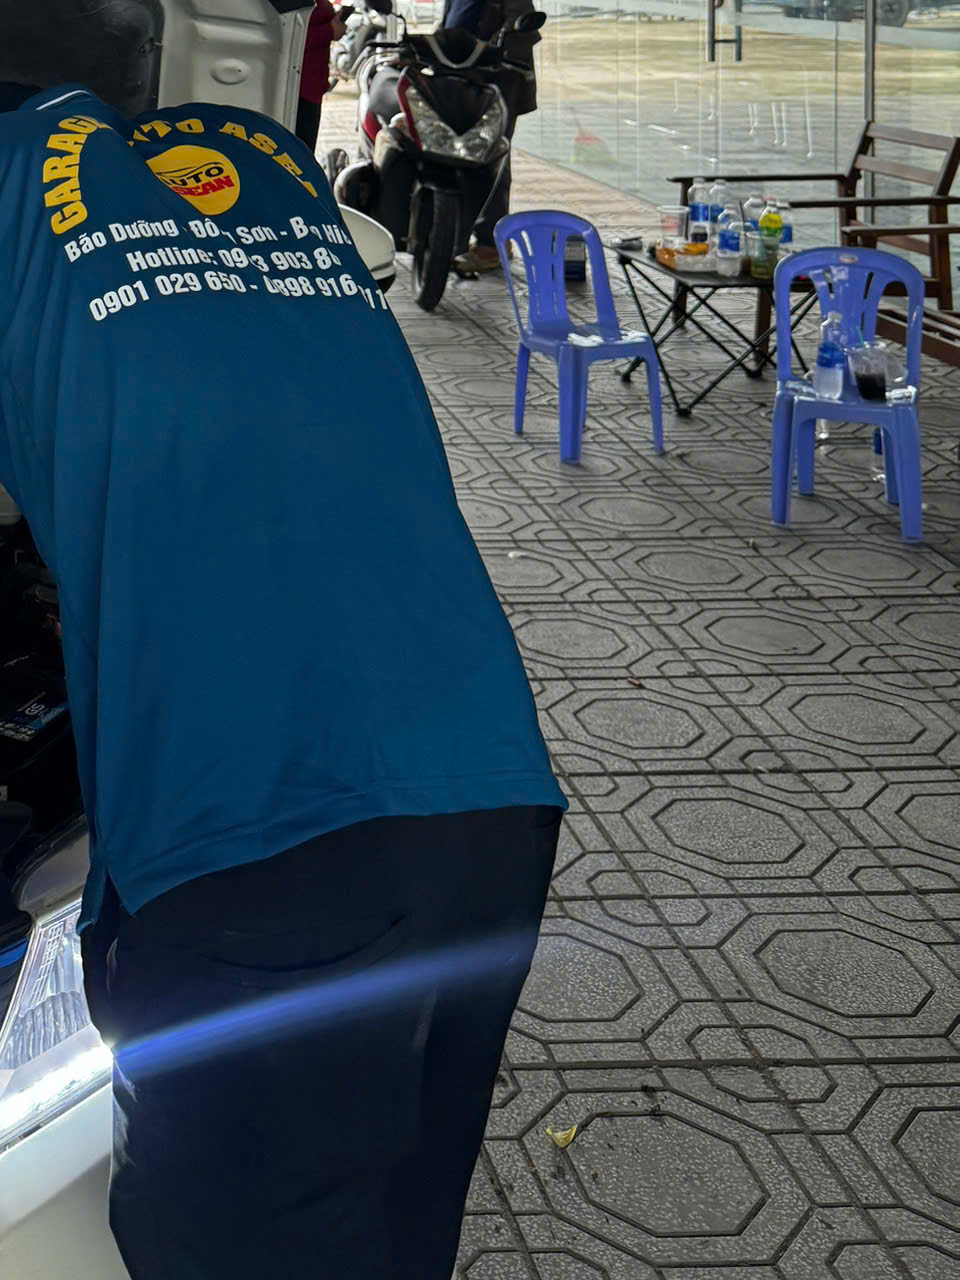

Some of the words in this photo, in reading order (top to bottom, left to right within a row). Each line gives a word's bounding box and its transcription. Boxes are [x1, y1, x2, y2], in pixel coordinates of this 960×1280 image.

[108, 219, 179, 243] Dưỡng
[236, 225, 279, 245] Sơn
[126, 246, 218, 272] Hotline:
[270, 251, 313, 270] 903
[89, 280, 150, 321] 0901
[155, 272, 202, 296] 029
[204, 270, 247, 293] 650
[315, 273, 358, 298] 916
